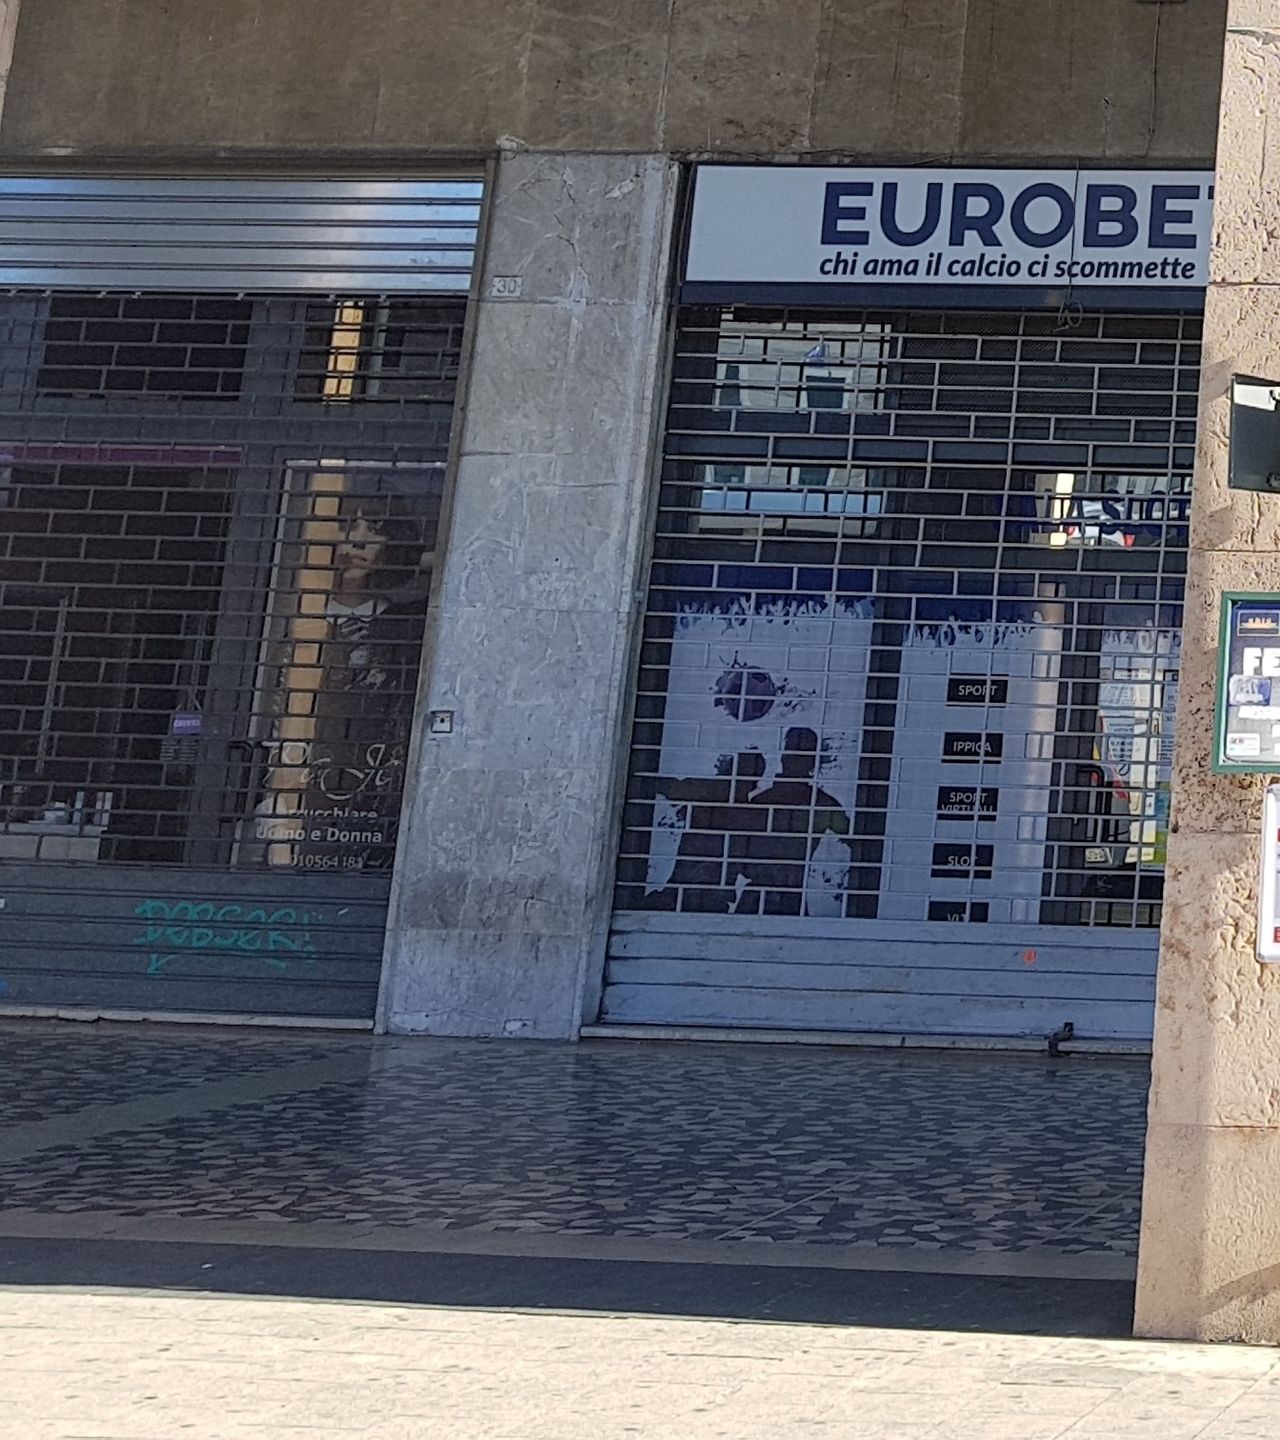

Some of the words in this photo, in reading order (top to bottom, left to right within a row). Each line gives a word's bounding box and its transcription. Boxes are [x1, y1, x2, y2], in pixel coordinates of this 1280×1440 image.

[820, 181, 1214, 249] EUROBE
[819, 252, 859, 277] chi
[863, 259, 919, 277] ama
[925, 253, 941, 277] il
[946, 253, 1023, 279] calcio
[1027, 255, 1048, 279] ci
[1054, 258, 1196, 281] scommette
[958, 685, 998, 696] SPORT
[953, 740, 992, 753] IPPICA
[949, 791, 988, 804] SPORT
[311, 828, 321, 841] e
[326, 827, 383, 843] Donna
